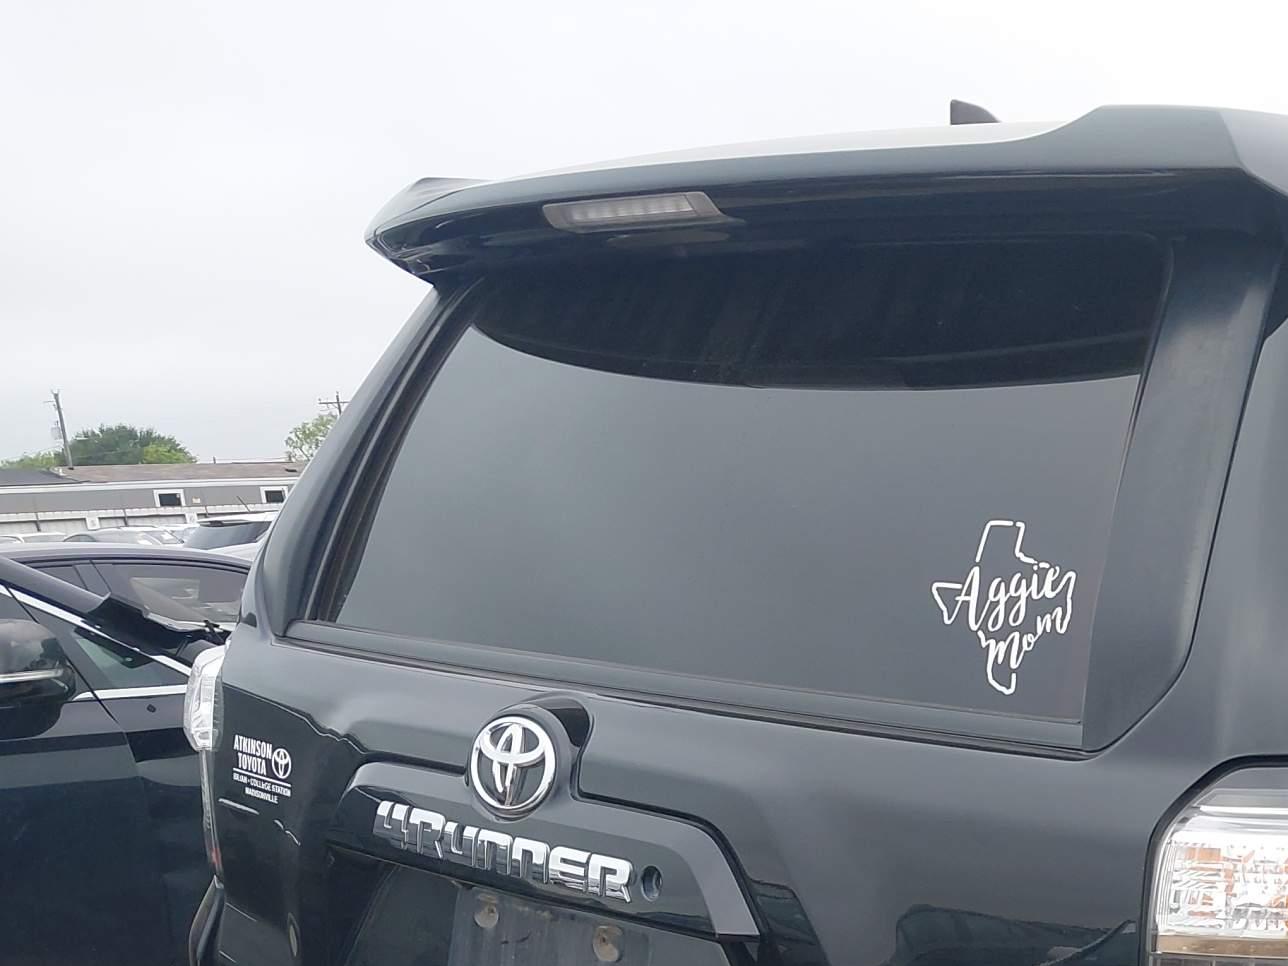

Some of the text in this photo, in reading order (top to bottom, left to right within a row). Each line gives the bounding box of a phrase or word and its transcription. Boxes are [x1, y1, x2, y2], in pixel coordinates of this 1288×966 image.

[947, 565, 1062, 633] Aggie
[234, 735, 272, 759] ATKINSON
[238, 753, 266, 775] TOYOTA
[372, 800, 634, 903] 4RUNNER
